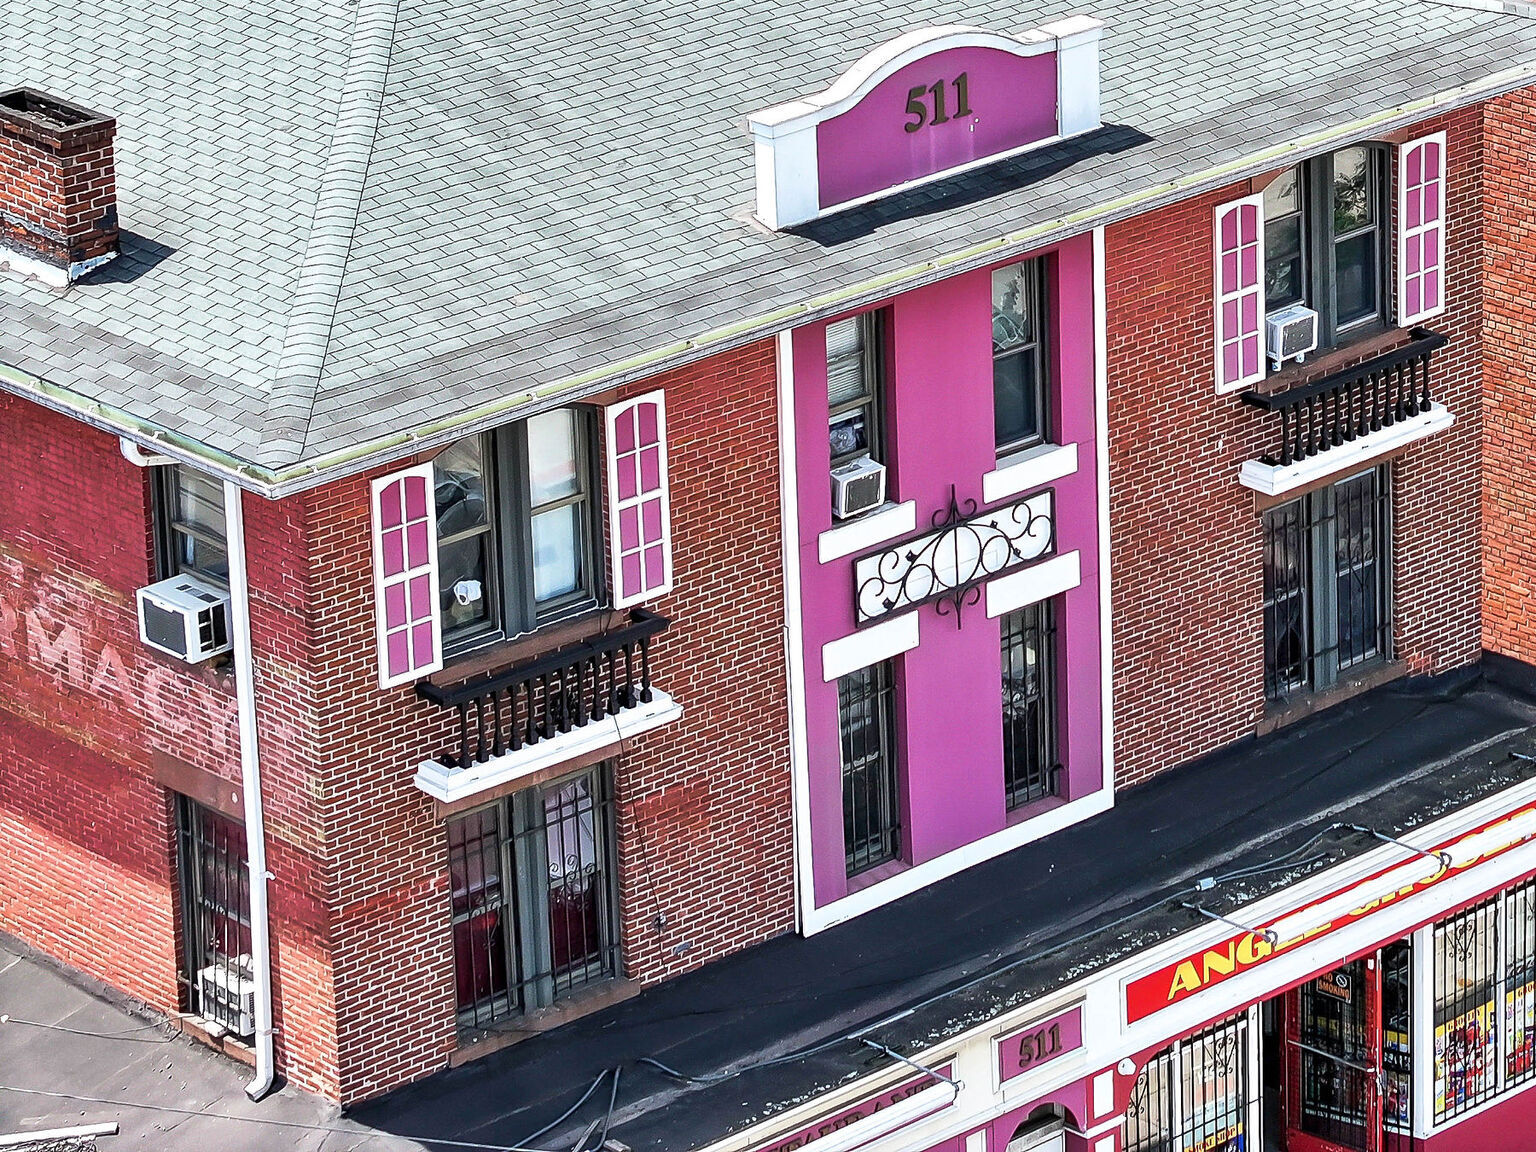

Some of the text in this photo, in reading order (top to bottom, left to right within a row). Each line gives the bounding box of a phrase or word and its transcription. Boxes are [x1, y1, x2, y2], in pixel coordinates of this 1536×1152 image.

[904, 71, 973, 133] 511
[1318, 980, 1350, 999] SMOKING
[1019, 1024, 1063, 1068] 511
